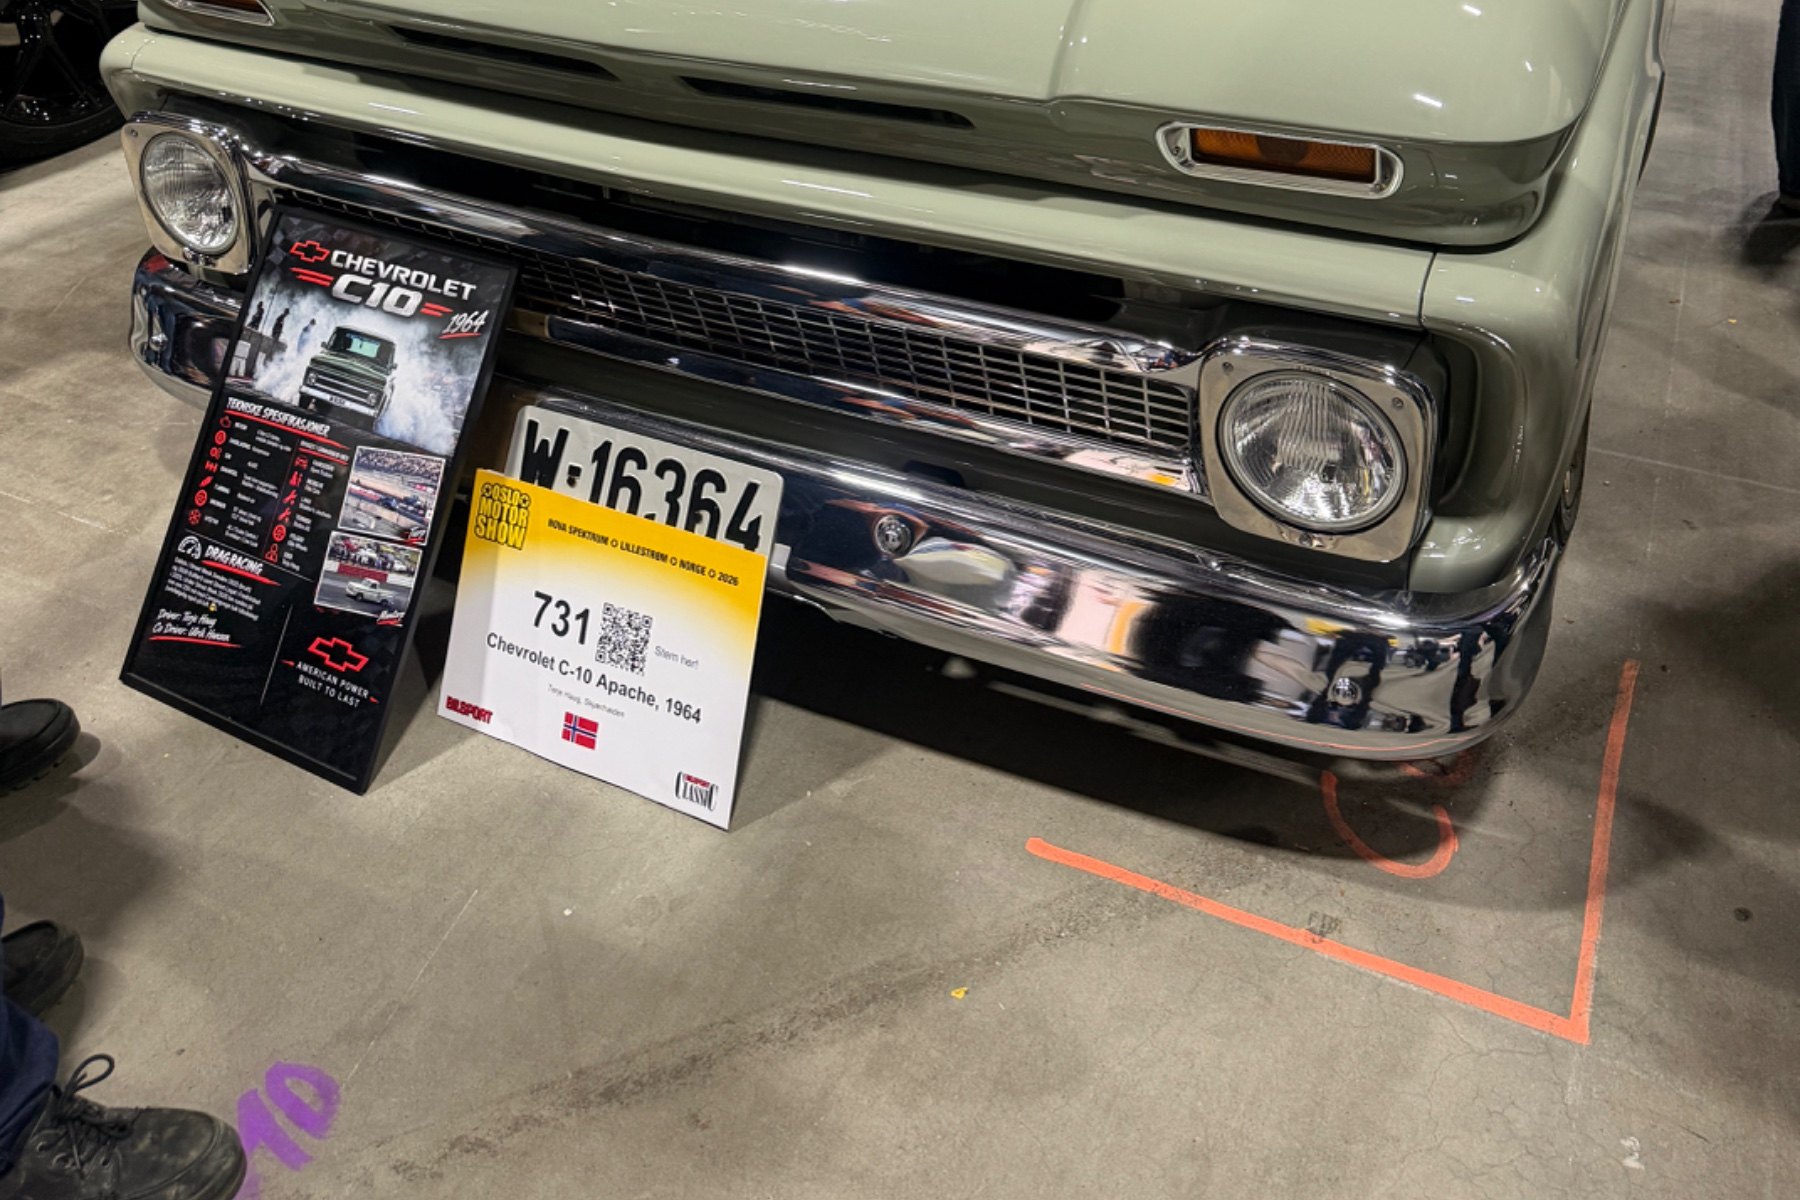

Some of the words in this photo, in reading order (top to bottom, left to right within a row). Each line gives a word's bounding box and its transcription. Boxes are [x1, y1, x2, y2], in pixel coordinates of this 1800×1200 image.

[331, 249, 477, 301] CHEVROLET
[331, 274, 423, 318] C10
[442, 309, 490, 335] 1964
[480, 499, 529, 524] MOTOR
[493, 483, 521, 506] OSLO
[474, 517, 527, 550] SHOW
[716, 570, 740, 587] 2026
[534, 590, 591, 646] 731
[295, 661, 338, 686] AMERICAN
[339, 679, 369, 699] POWER
[298, 674, 323, 692] BUILT
[325, 684, 337, 698] TO
[337, 692, 361, 709] LAST
[486, 632, 555, 671] Chevrolet
[559, 660, 593, 685] C-10
[596, 674, 660, 712] Apache,
[665, 698, 702, 725] 1964
